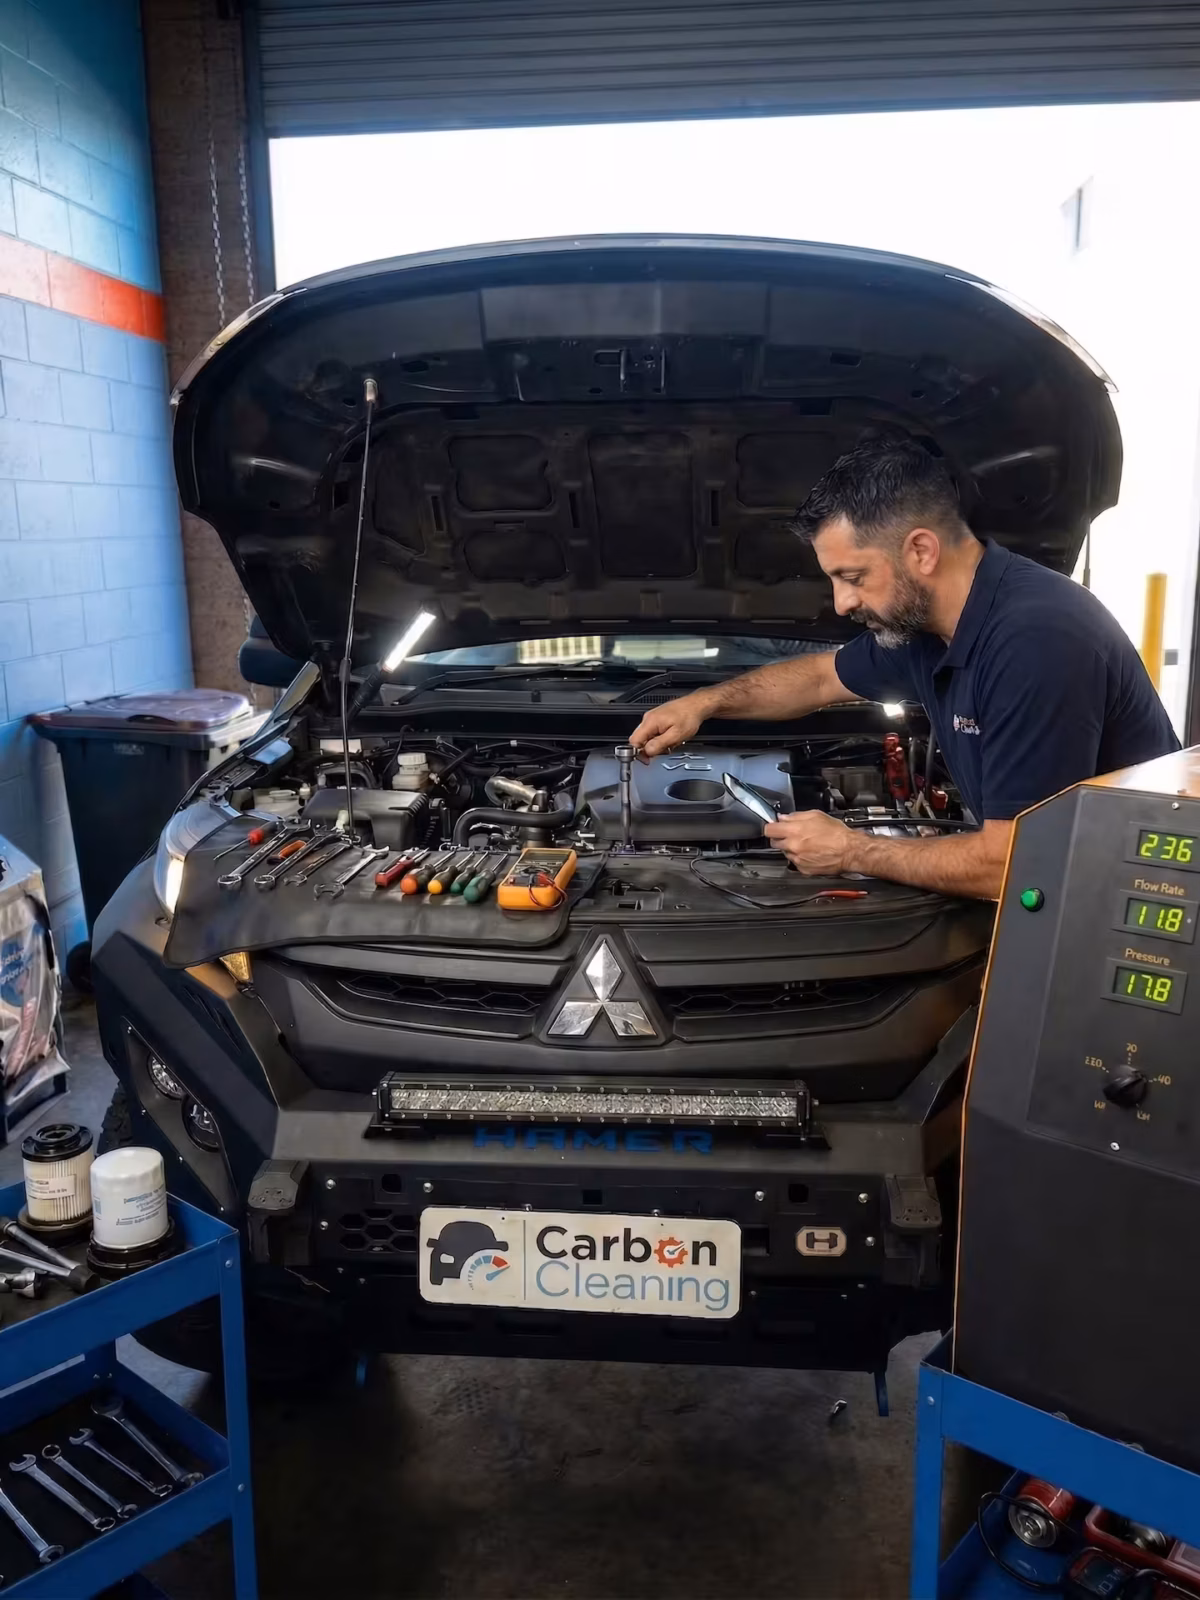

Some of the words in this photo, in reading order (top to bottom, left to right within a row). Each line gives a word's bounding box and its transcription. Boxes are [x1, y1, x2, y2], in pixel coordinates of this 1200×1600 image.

[1140, 833, 1194, 862] 236
[1134, 879, 1159, 892] Flow
[1160, 882, 1185, 896] Rate
[1124, 947, 1171, 966] Pressure
[1127, 974, 1172, 1002] 17.8
[474, 1126, 713, 1153] HAMER
[535, 1260, 730, 1312] Cleaning
